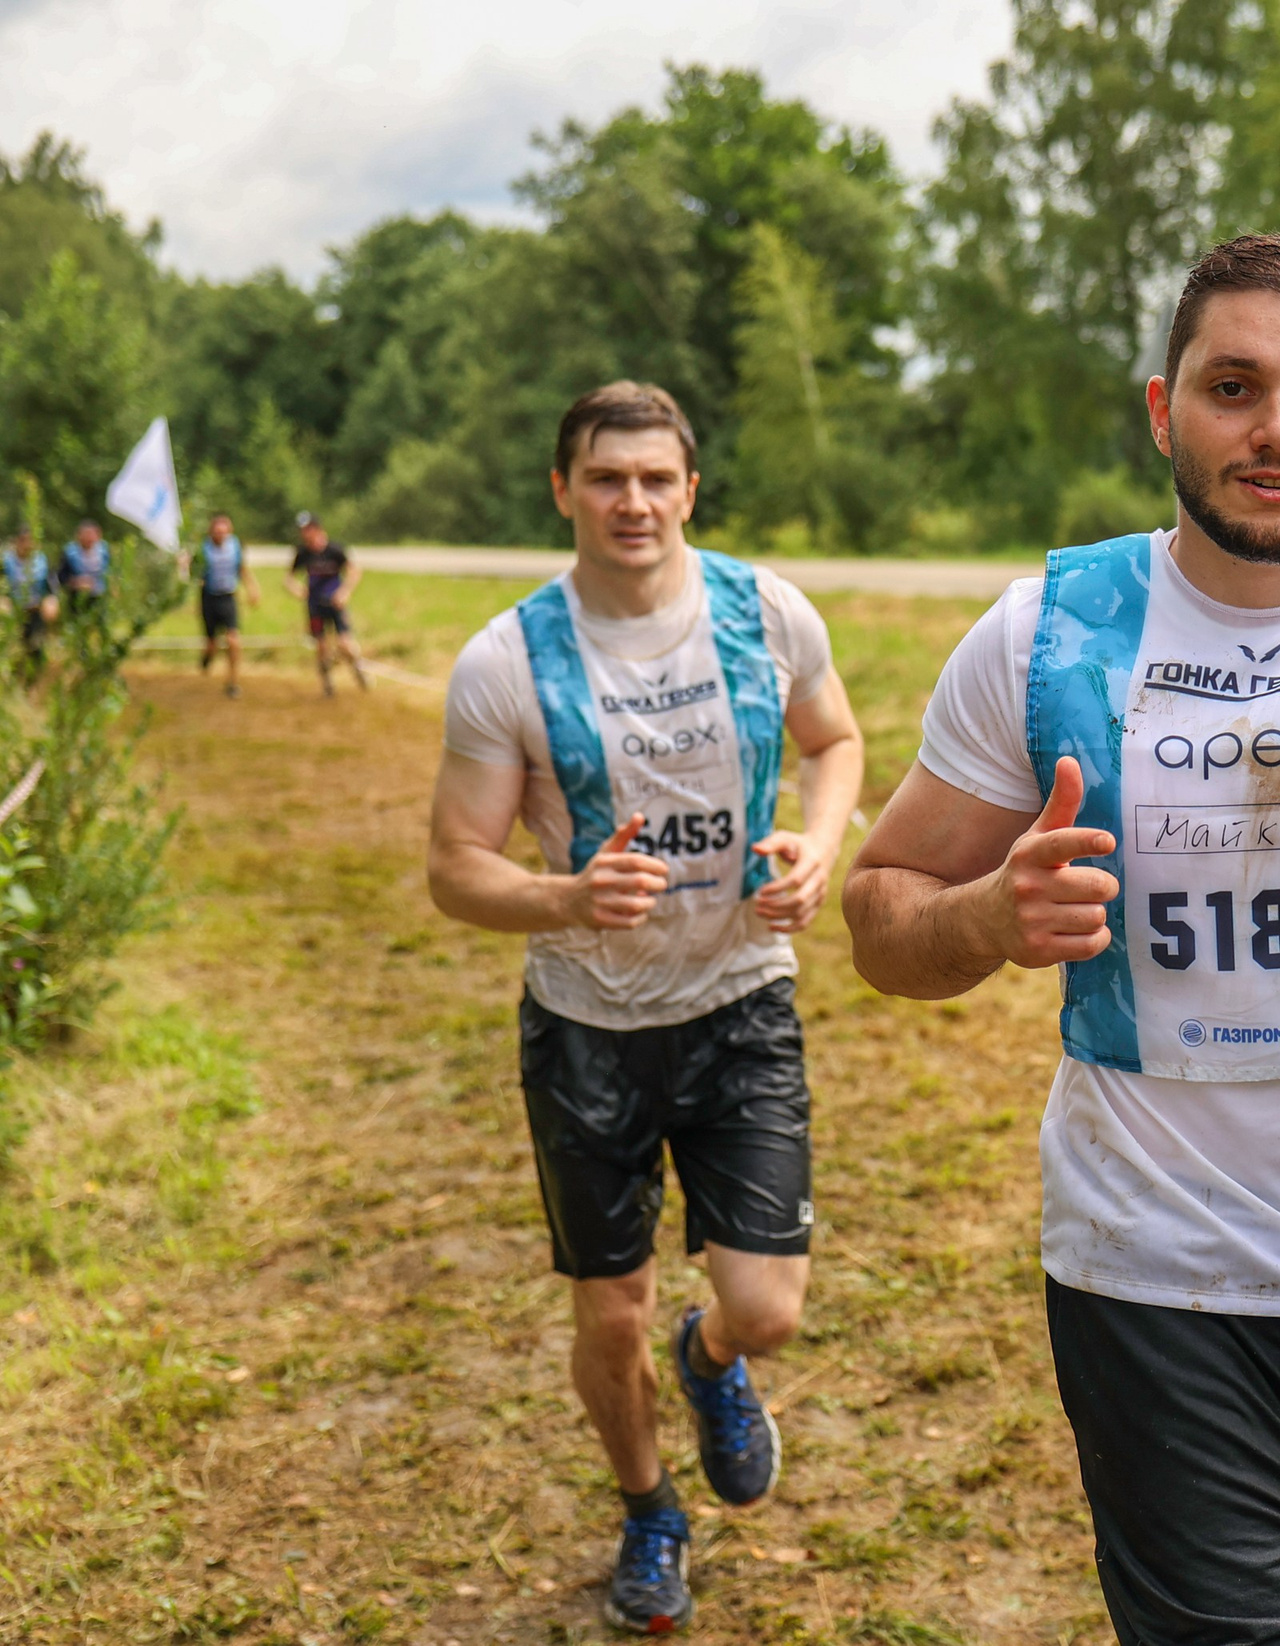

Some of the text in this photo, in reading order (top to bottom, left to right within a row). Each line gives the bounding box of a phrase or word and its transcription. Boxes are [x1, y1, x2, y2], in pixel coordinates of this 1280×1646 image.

[1145, 662, 1239, 695] ГОНКА
[622, 723, 717, 760] apex
[1155, 812, 1278, 850] Майк
